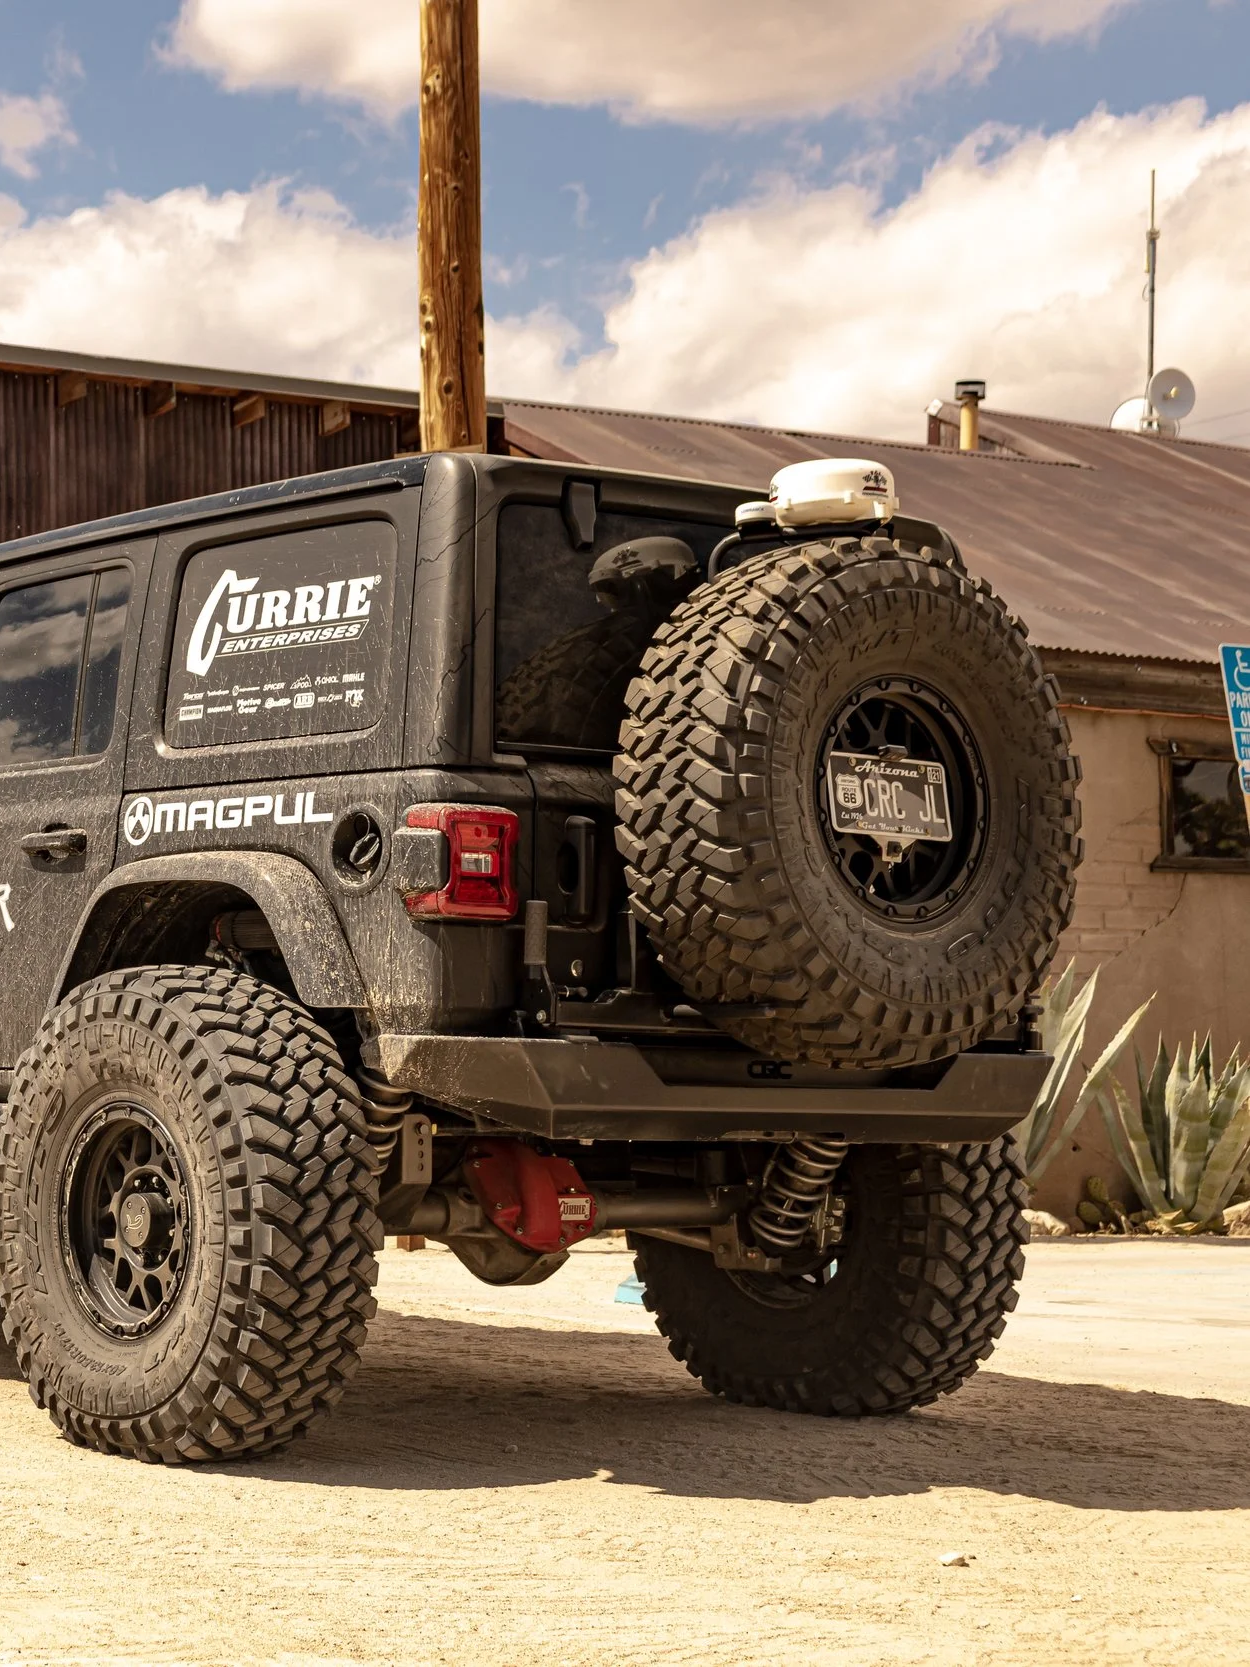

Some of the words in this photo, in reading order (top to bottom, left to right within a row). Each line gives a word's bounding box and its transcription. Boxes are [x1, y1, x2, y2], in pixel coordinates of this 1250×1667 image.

[186, 568, 375, 677] CURRIE
[221, 623, 361, 654] ENTERPRISES
[855, 760, 919, 778] Arizona
[154, 791, 334, 834] MAGPUL
[843, 793, 857, 804] 66
[863, 778, 906, 820] CRC
[919, 784, 946, 824] JL
